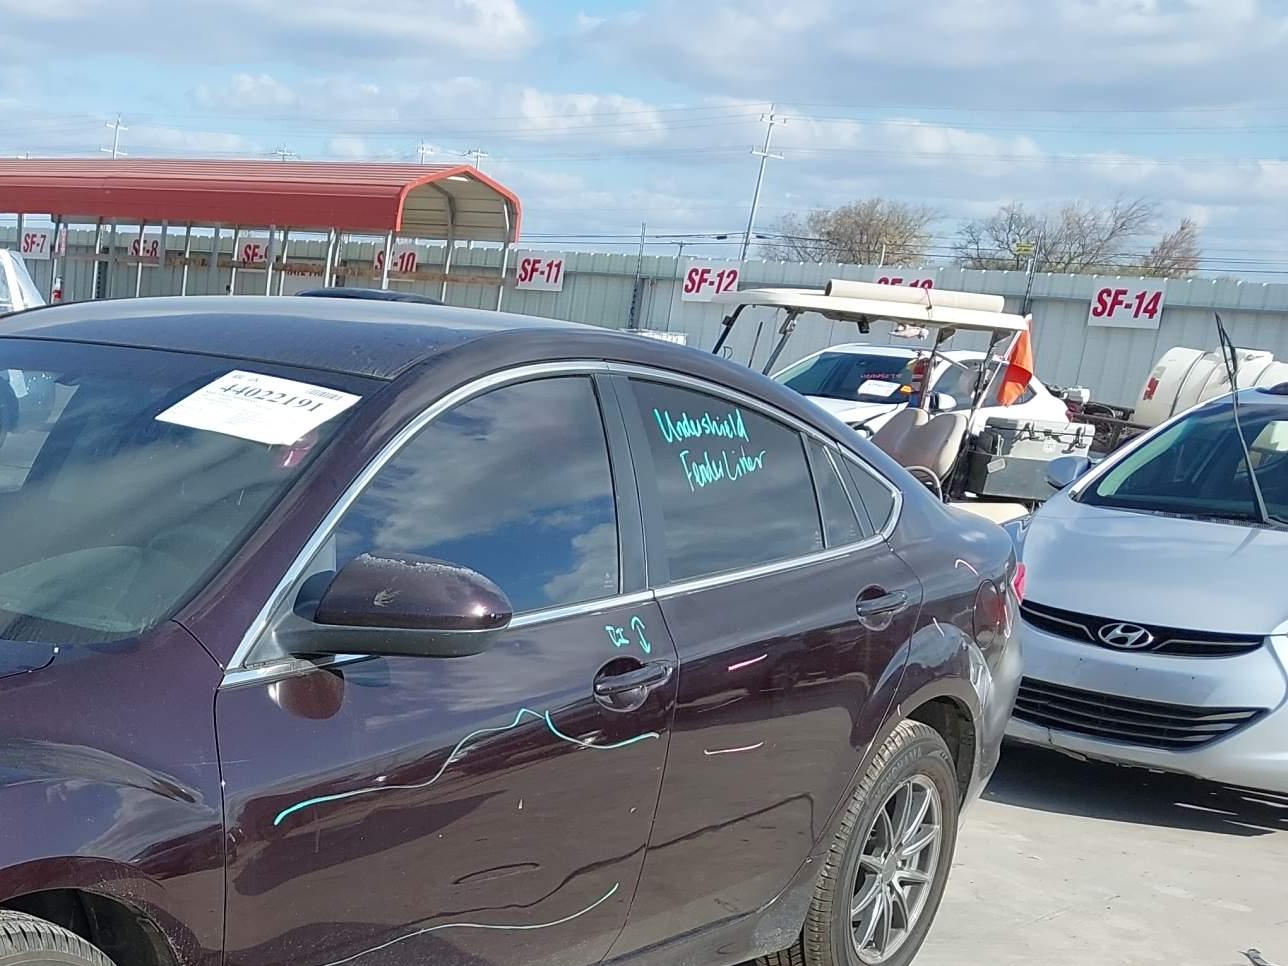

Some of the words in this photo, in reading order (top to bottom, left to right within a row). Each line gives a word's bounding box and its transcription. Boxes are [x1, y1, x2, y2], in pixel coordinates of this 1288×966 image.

[22, 233, 47, 254] SF-7
[374, 250, 417, 273] S-10
[518, 258, 563, 284] SF-11
[683, 268, 739, 294] SF-12
[1091, 287, 1163, 319] SF-14
[220, 383, 324, 412] 44022191
